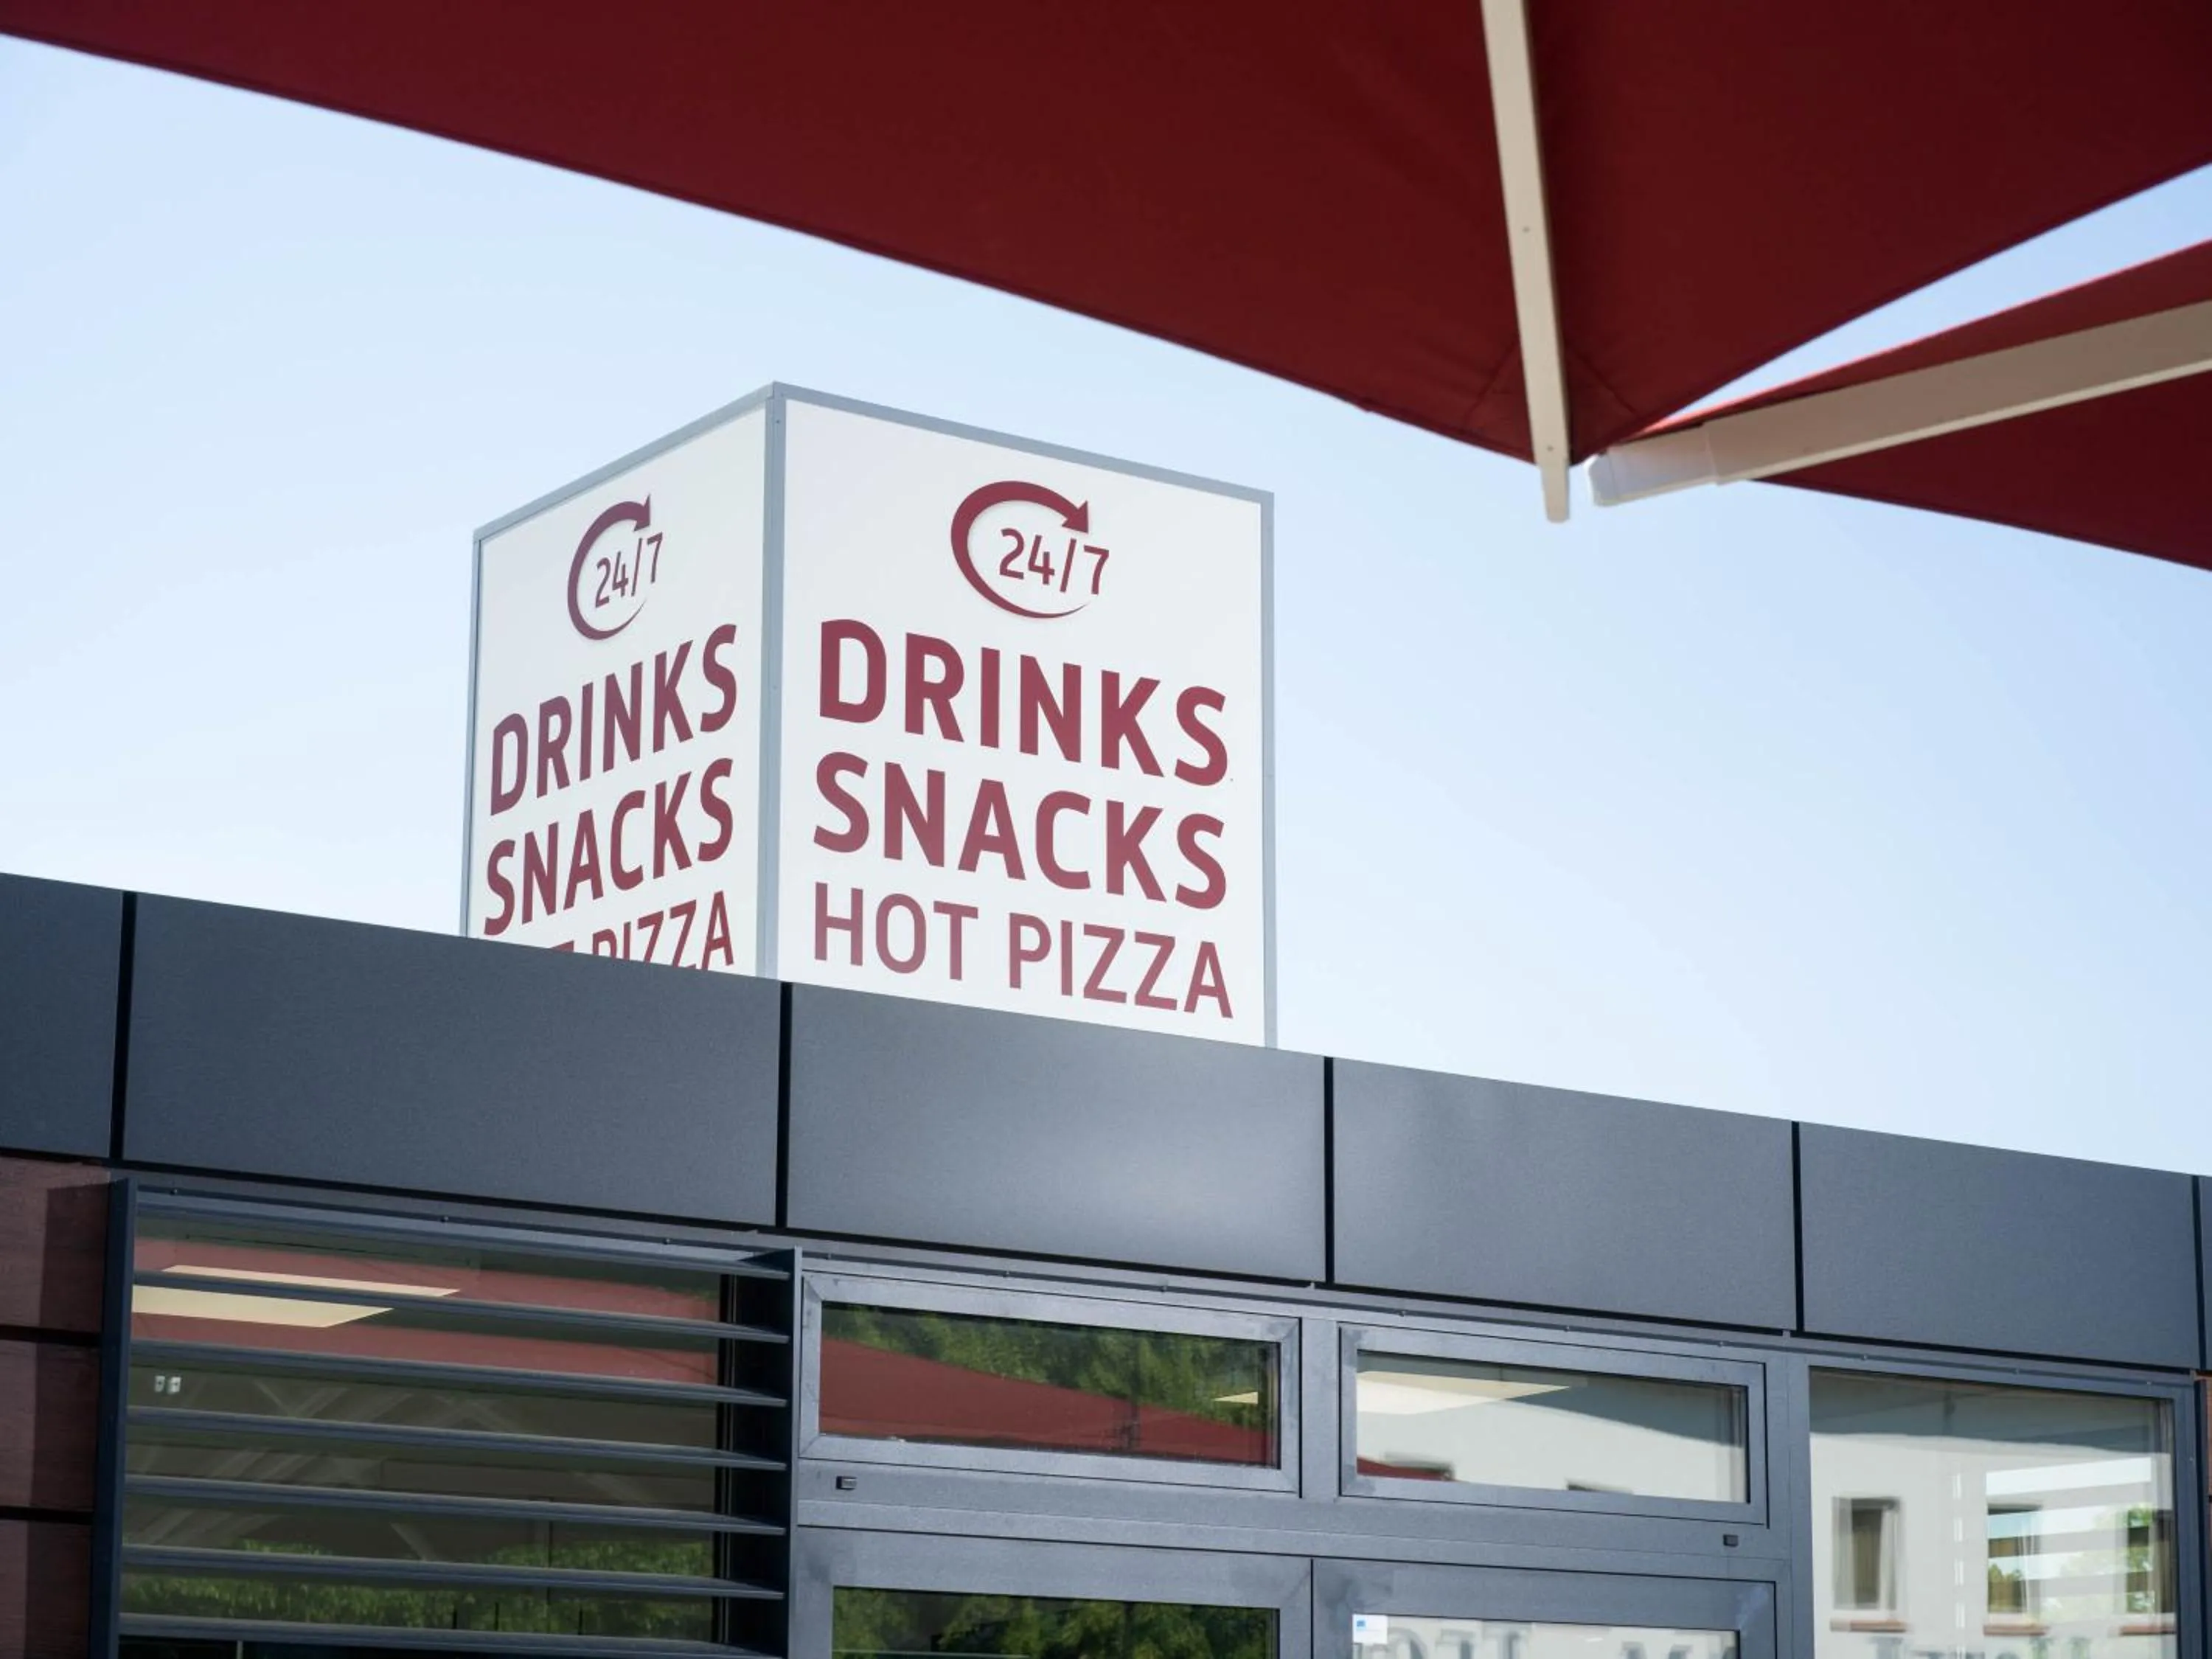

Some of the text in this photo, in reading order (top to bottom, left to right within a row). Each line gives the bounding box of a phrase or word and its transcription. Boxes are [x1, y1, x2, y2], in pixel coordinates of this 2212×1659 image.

[594, 532, 664, 609] 24/7
[998, 527, 1110, 595] 24/7
[490, 624, 737, 815] DRINKS
[819, 618, 1228, 787] DRINKS
[484, 757, 733, 936] SNACKS
[813, 751, 1228, 911] SNACKS
[814, 882, 1234, 1019] HOT PIZZA
